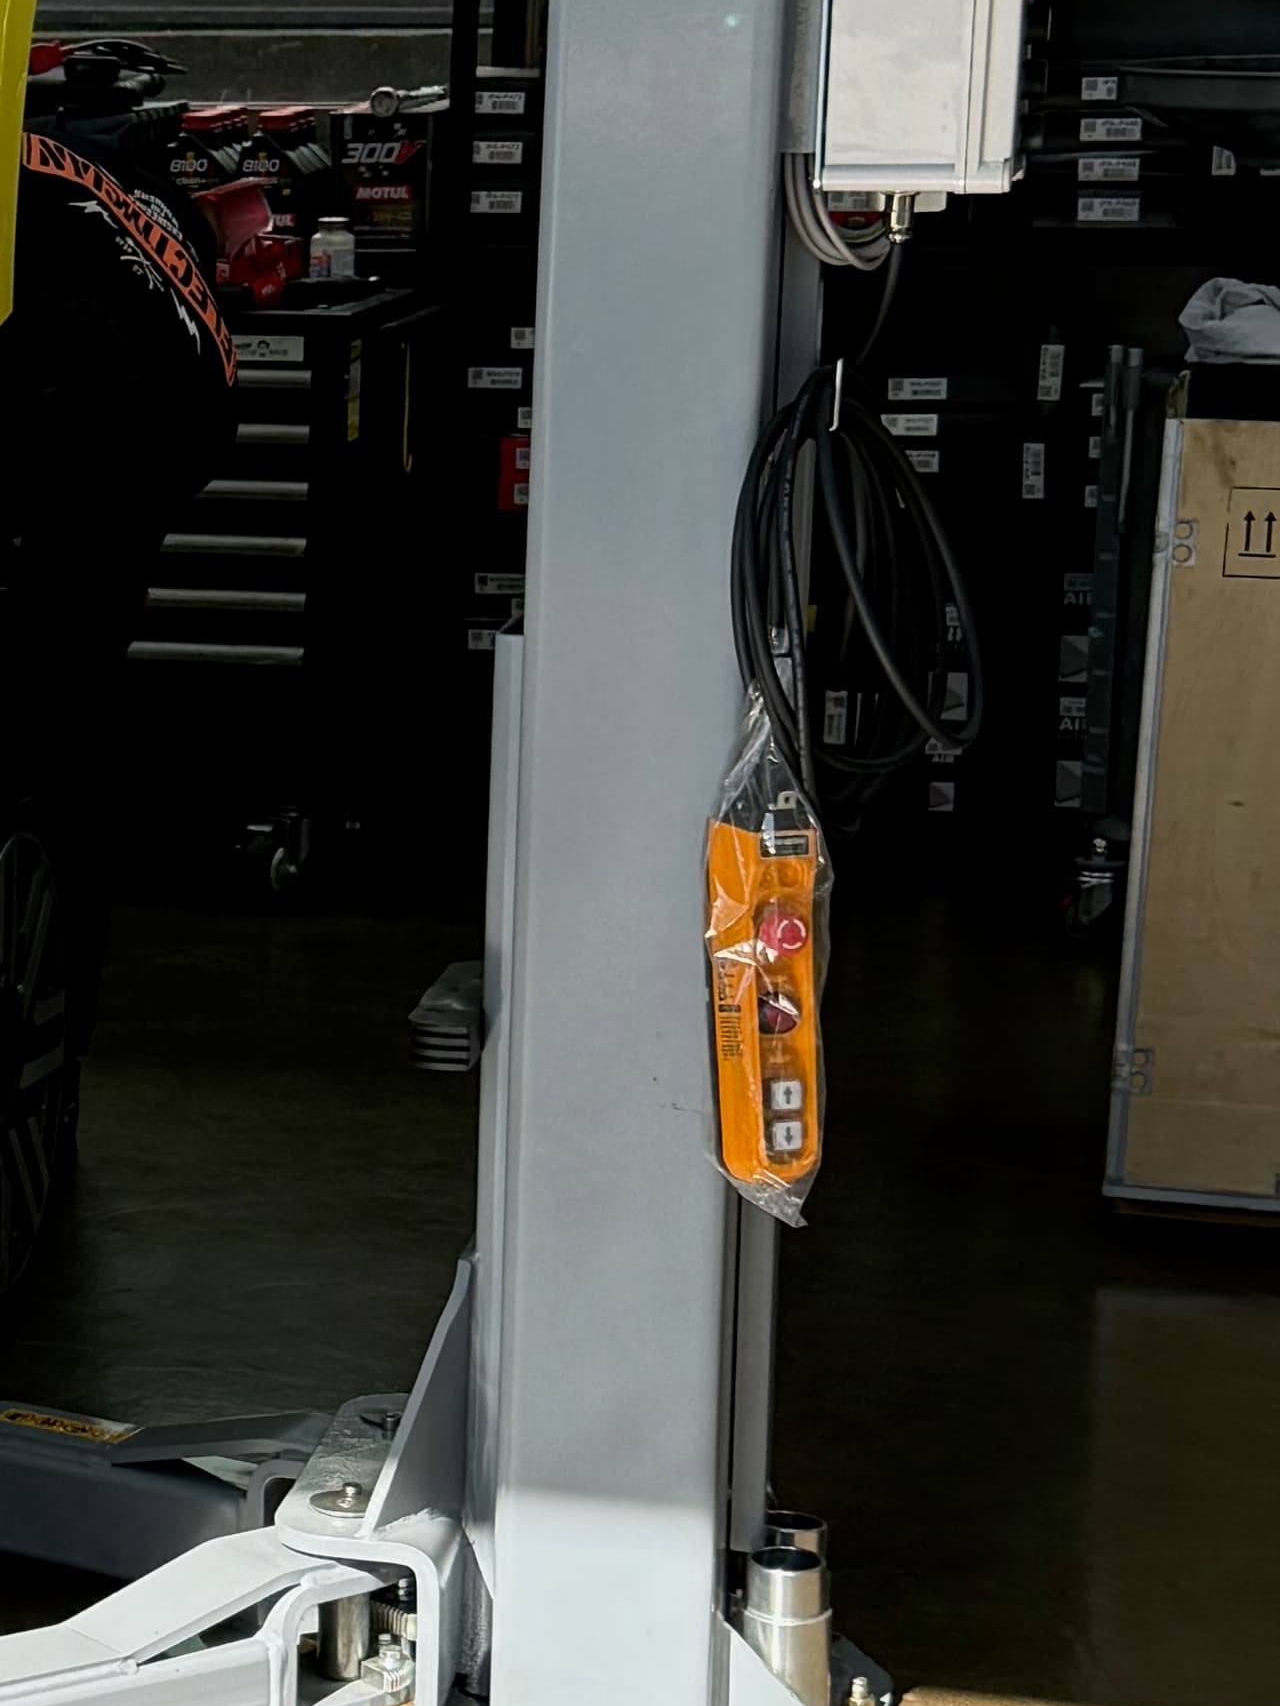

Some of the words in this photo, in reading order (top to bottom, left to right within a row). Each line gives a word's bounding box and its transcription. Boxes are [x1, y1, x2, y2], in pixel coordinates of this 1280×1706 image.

[340, 140, 428, 165] 300V
[169, 158, 208, 173] 8100
[242, 158, 280, 173] 8100
[355, 186, 409, 200] MOTUL
